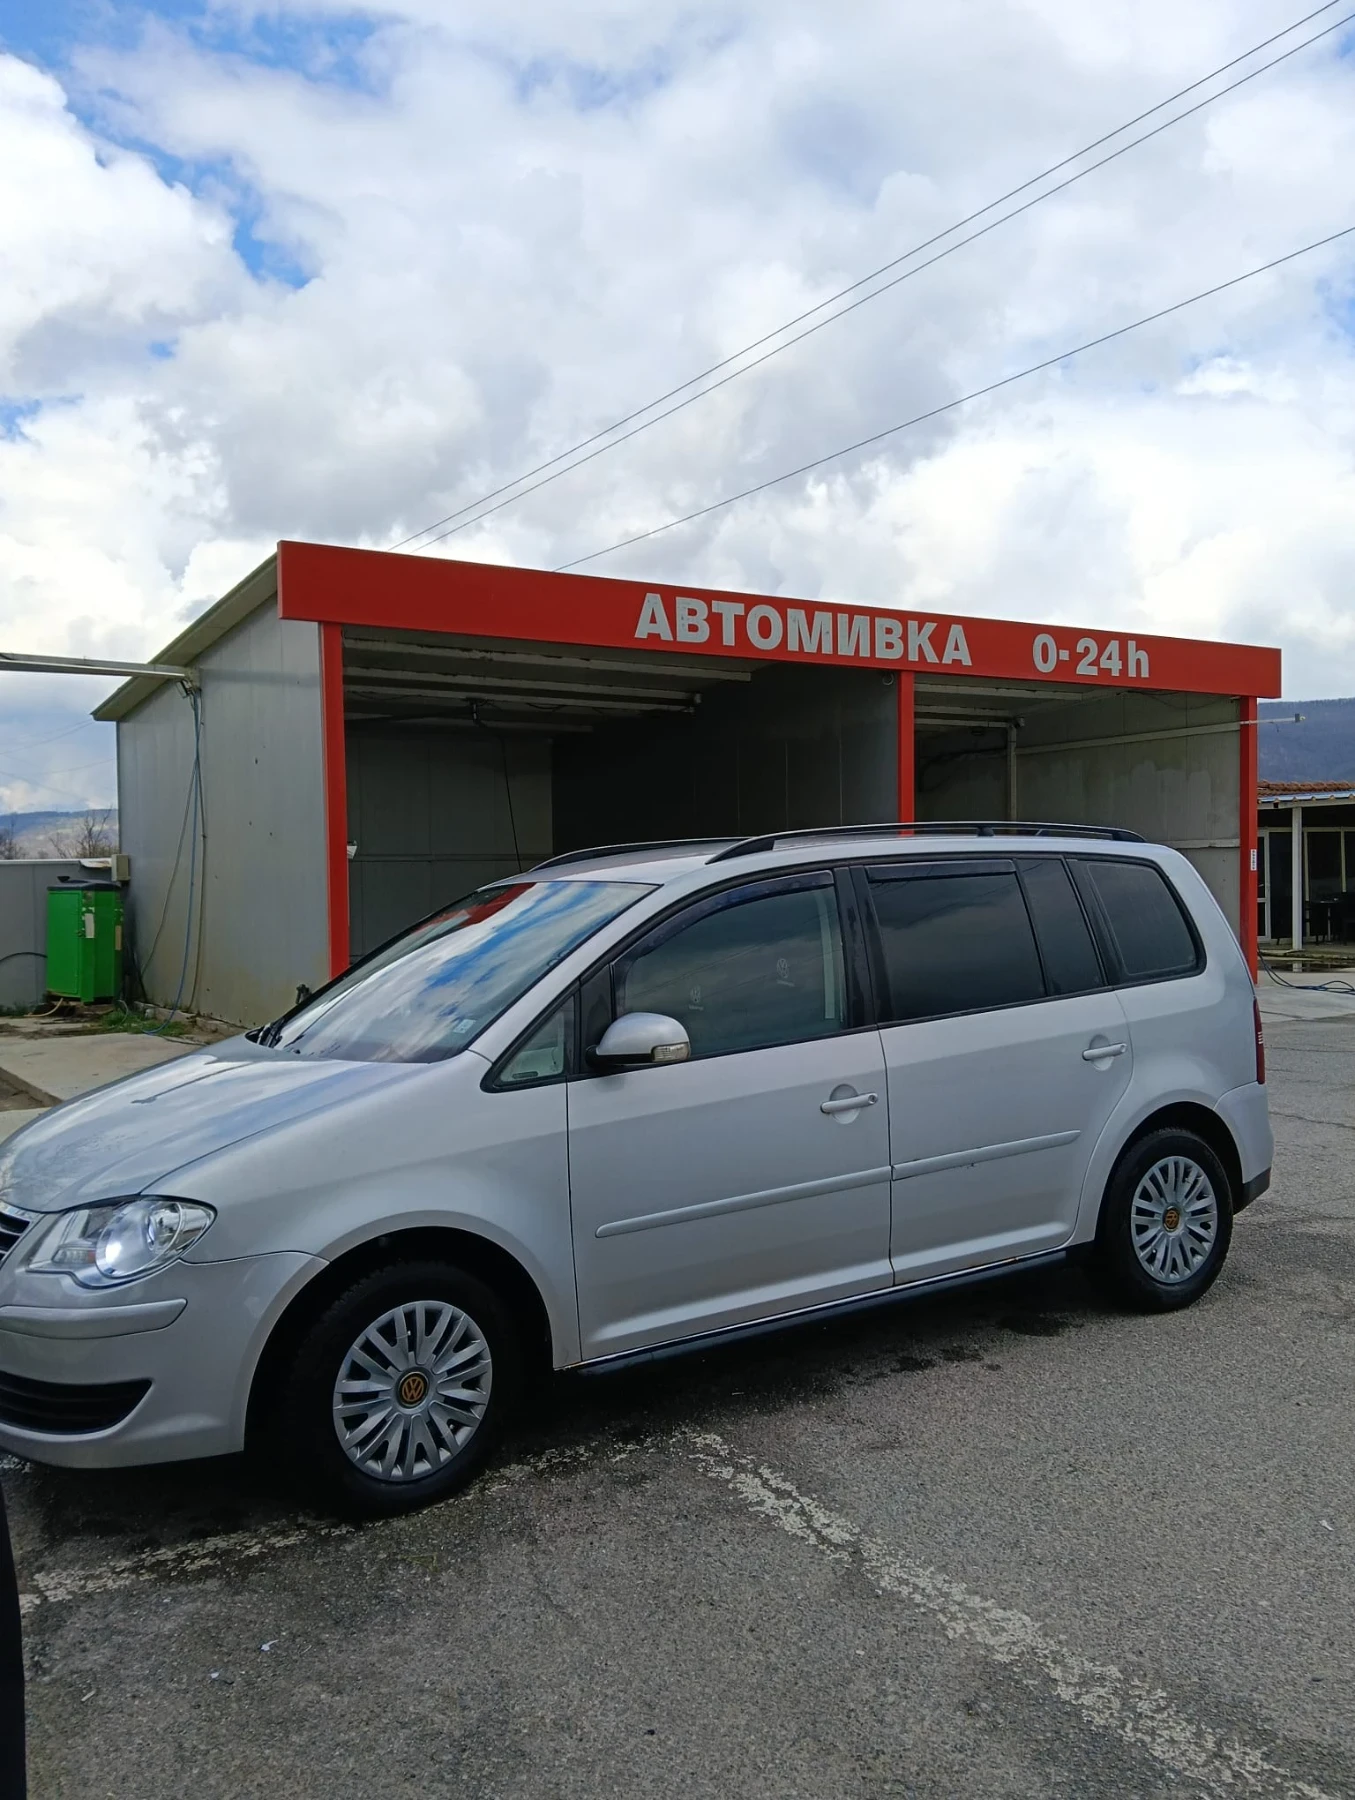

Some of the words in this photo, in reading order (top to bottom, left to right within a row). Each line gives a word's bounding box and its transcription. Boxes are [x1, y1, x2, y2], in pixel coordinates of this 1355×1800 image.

[634, 592, 974, 666] АВТОМИВКА
[1032, 633, 1149, 678] 0-24h
[402, 1377, 424, 1402] VW
